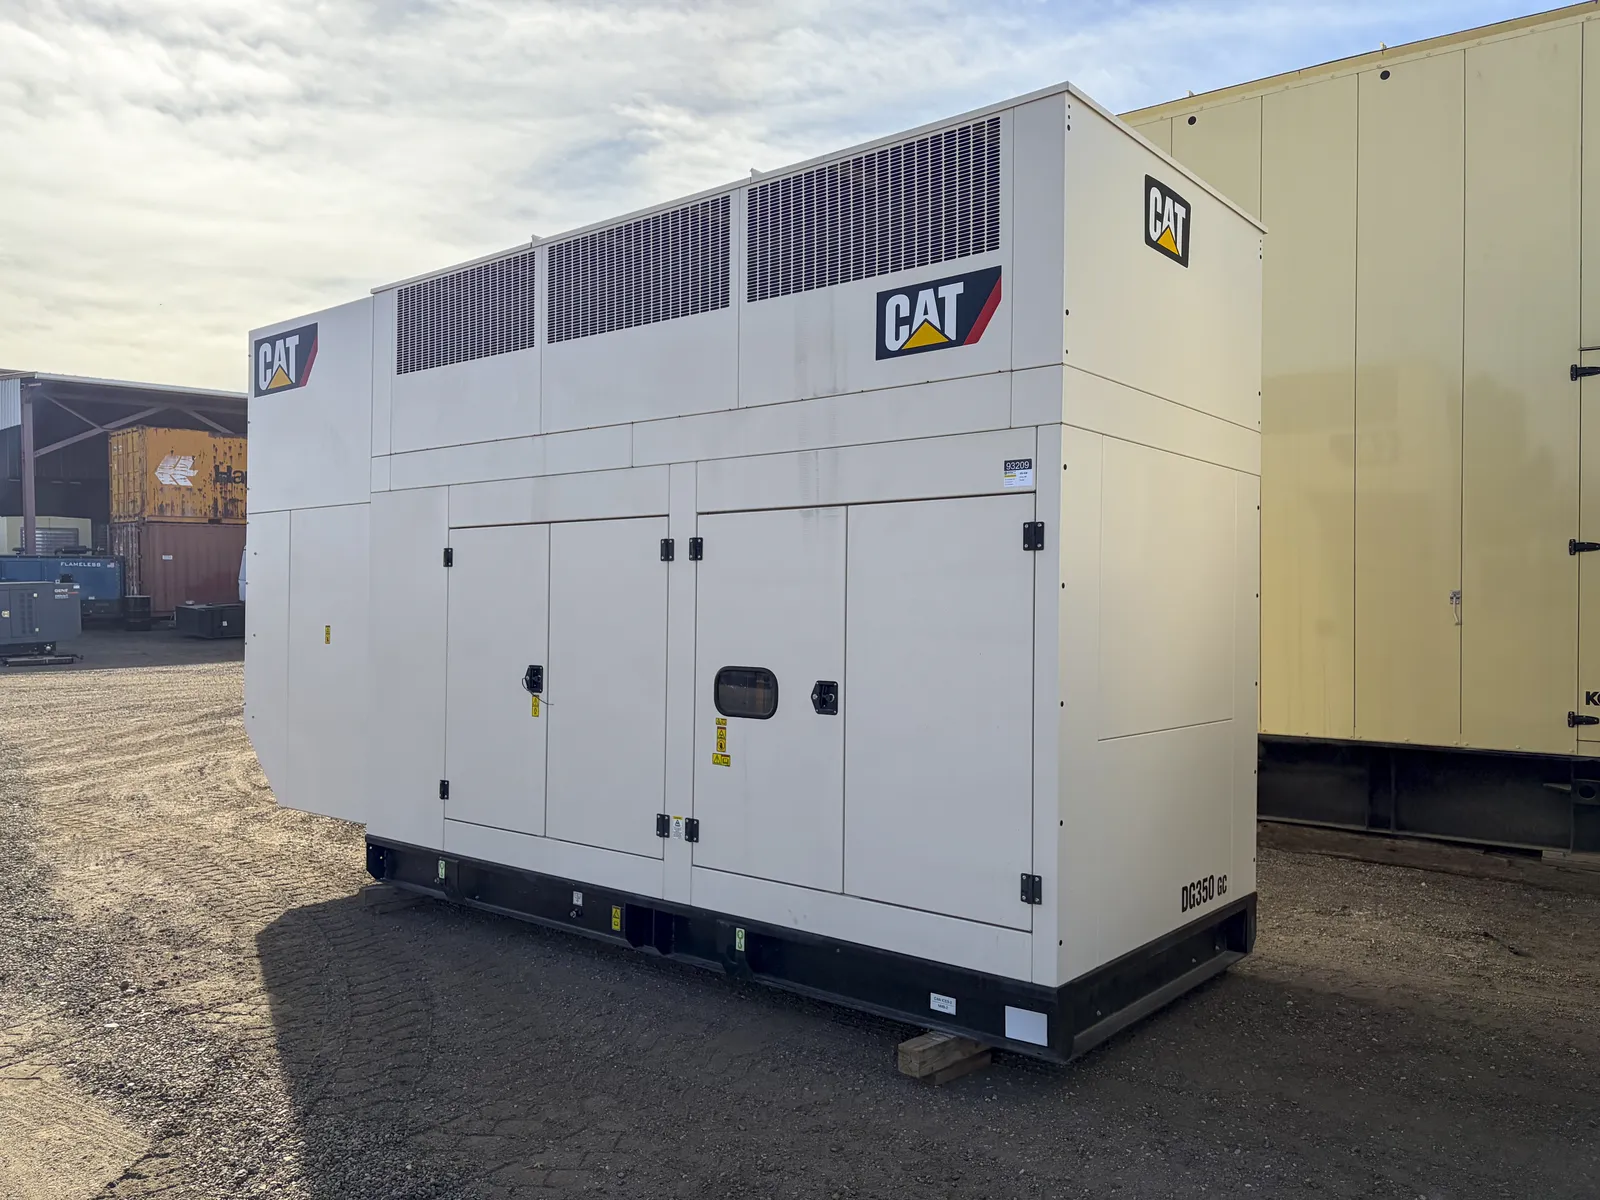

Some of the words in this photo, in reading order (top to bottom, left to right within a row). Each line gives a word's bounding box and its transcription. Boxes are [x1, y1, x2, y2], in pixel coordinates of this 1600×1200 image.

[1149, 186, 1187, 257] CAT
[885, 281, 964, 352] CAT
[258, 334, 300, 391] CAT
[213, 464, 247, 488] Ha
[1005, 460, 1030, 471] 93209
[1181, 874, 1215, 913] DG350
[1217, 874, 1228, 897] GC
